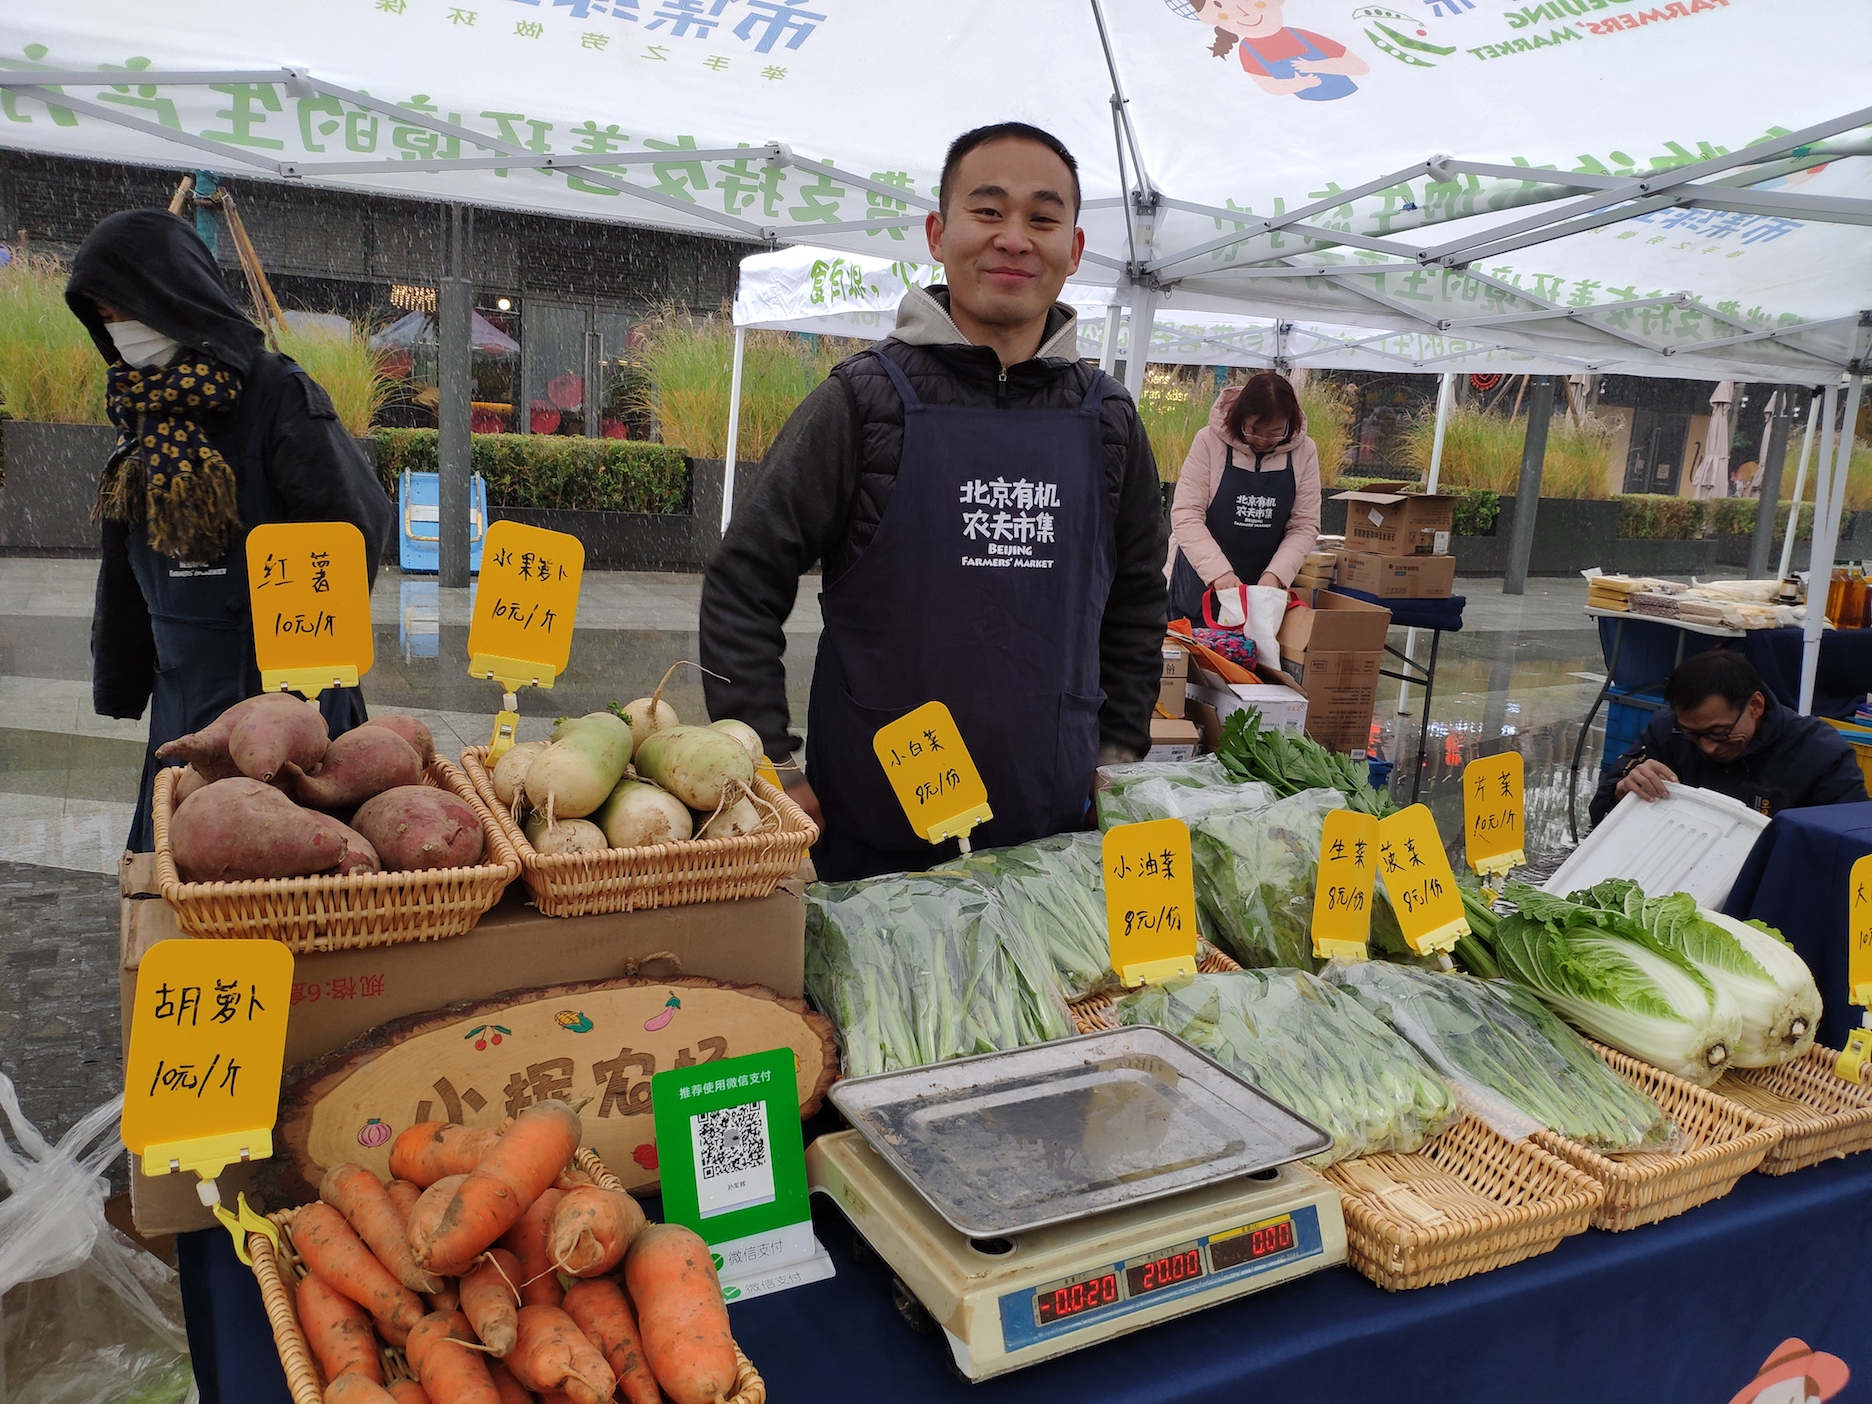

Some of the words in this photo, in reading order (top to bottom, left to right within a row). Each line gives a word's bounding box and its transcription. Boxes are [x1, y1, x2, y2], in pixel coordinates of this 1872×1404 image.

[960, 476, 1060, 510] 北京有机
[1236, 495, 1276, 508] 北京有机
[962, 509, 1055, 543] 农夫市集
[493, 548, 568, 582] 水果萝卜
[988, 543, 1033, 557] BEIJING
[1013, 558, 1054, 569] MARKET
[257, 551, 330, 593] 红薯
[275, 611, 336, 638] 10元/斤
[491, 598, 557, 634] 10元/斤
[890, 729, 945, 768] 小白菜
[915, 768, 961, 805] 8元/份
[1474, 770, 1514, 802] 芹菜
[1113, 848, 1177, 881] 小油菜
[1329, 837, 1368, 869] 生菜
[1380, 837, 1426, 873] 菠菜
[1328, 887, 1365, 912] 8元/份
[1403, 878, 1443, 912] 8元/份
[1855, 882, 1872, 908] 大
[1124, 905, 1182, 936] 8元/份
[155, 979, 265, 1026] 胡萝卜
[150, 1054, 242, 1098] 10元/斤
[679, 1070, 772, 1100] 推荐使用微信支付
[728, 1239, 783, 1266] 微信支付
[745, 1271, 802, 1294] 微信支付
[1143, 1250, 1198, 1289] 20.00
[1041, 1275, 1116, 1315] -0.020
